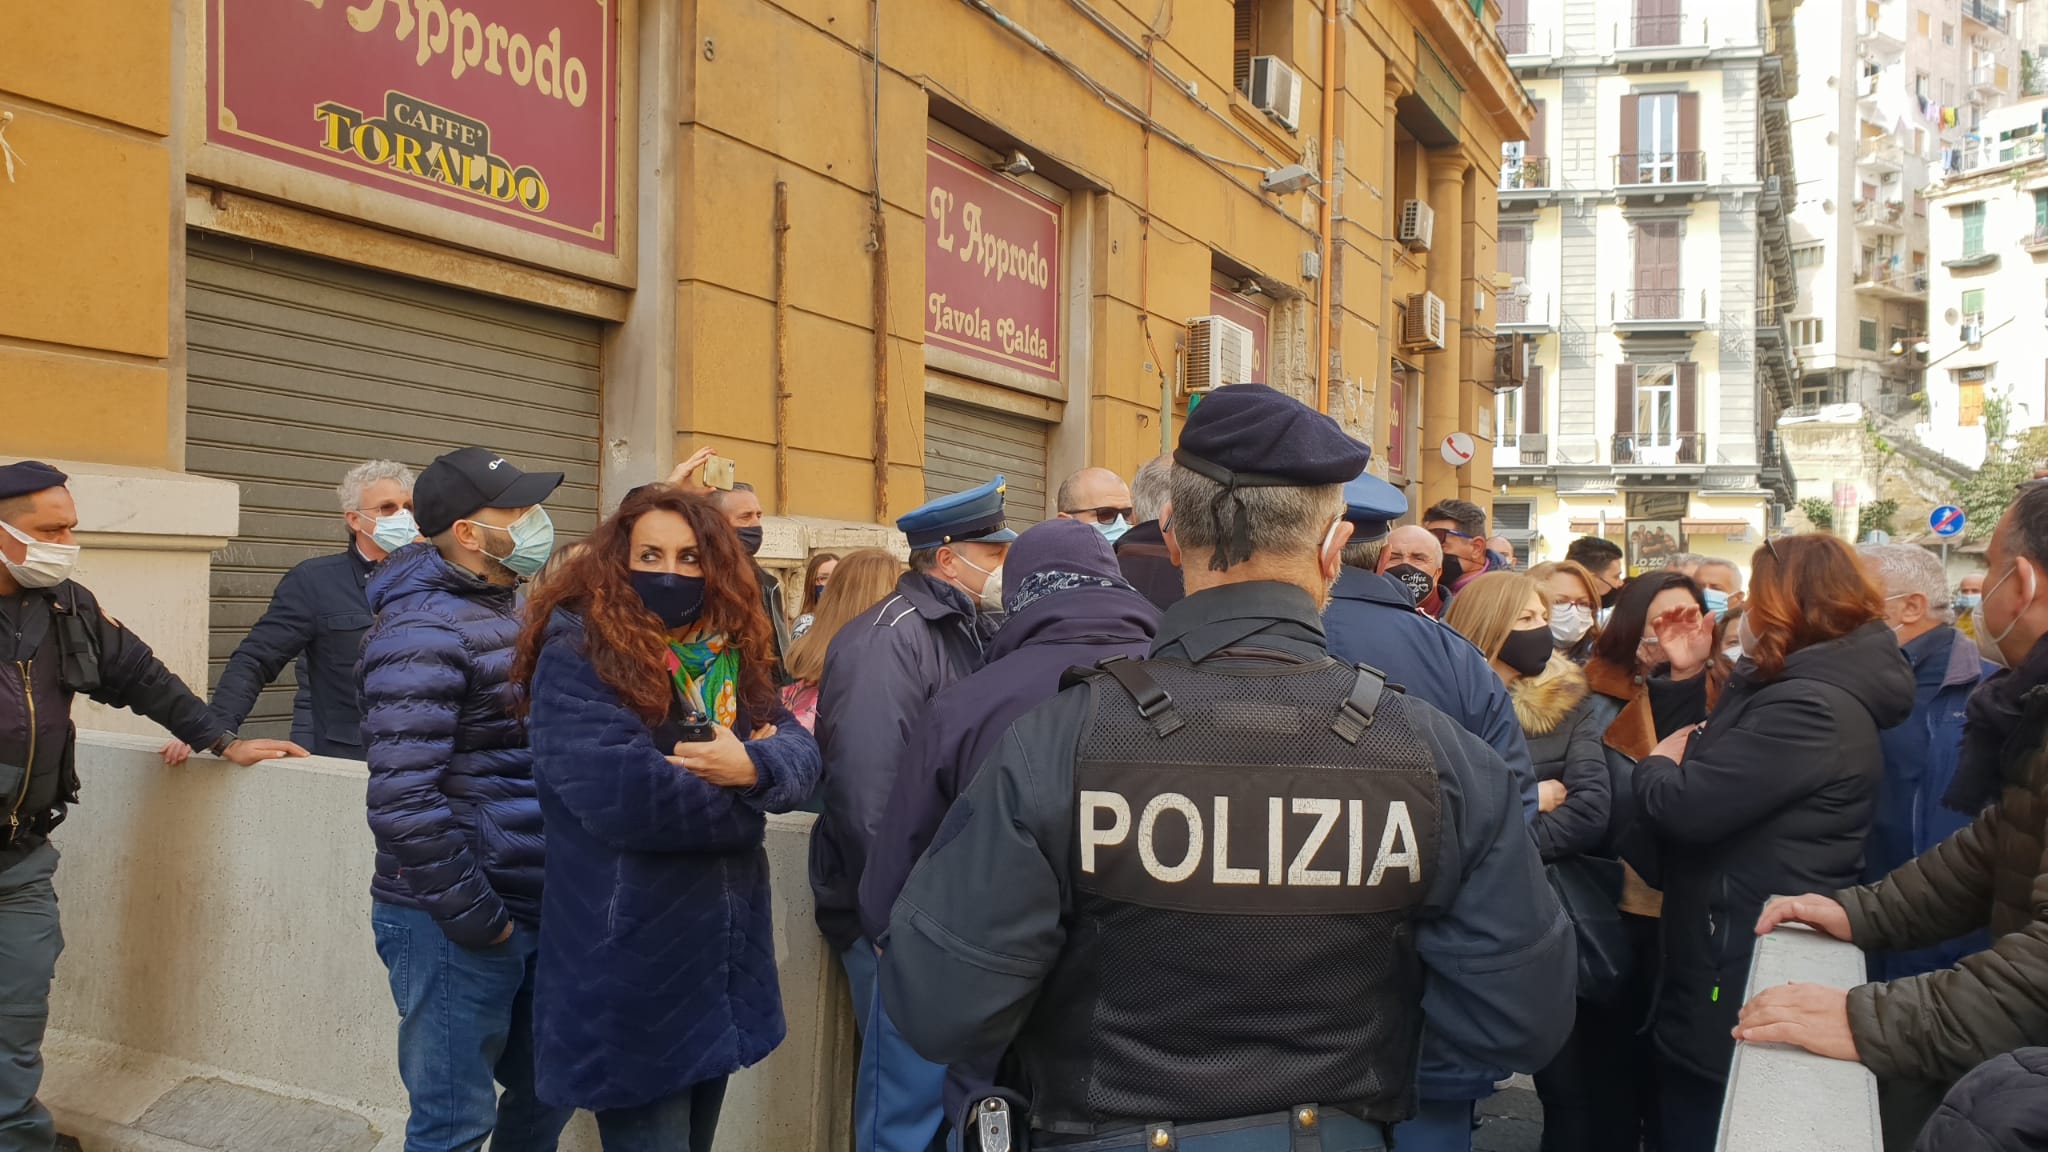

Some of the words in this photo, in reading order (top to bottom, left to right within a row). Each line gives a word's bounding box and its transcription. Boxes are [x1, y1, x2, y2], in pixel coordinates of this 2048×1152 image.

[316, 105, 549, 212] TORALDO
[959, 202, 1048, 289] Approdo
[928, 292, 991, 343] Tavola
[996, 318, 1048, 360] Calda
[1401, 572, 1427, 583] Coffee
[1080, 790, 1421, 886] POLIZIA
